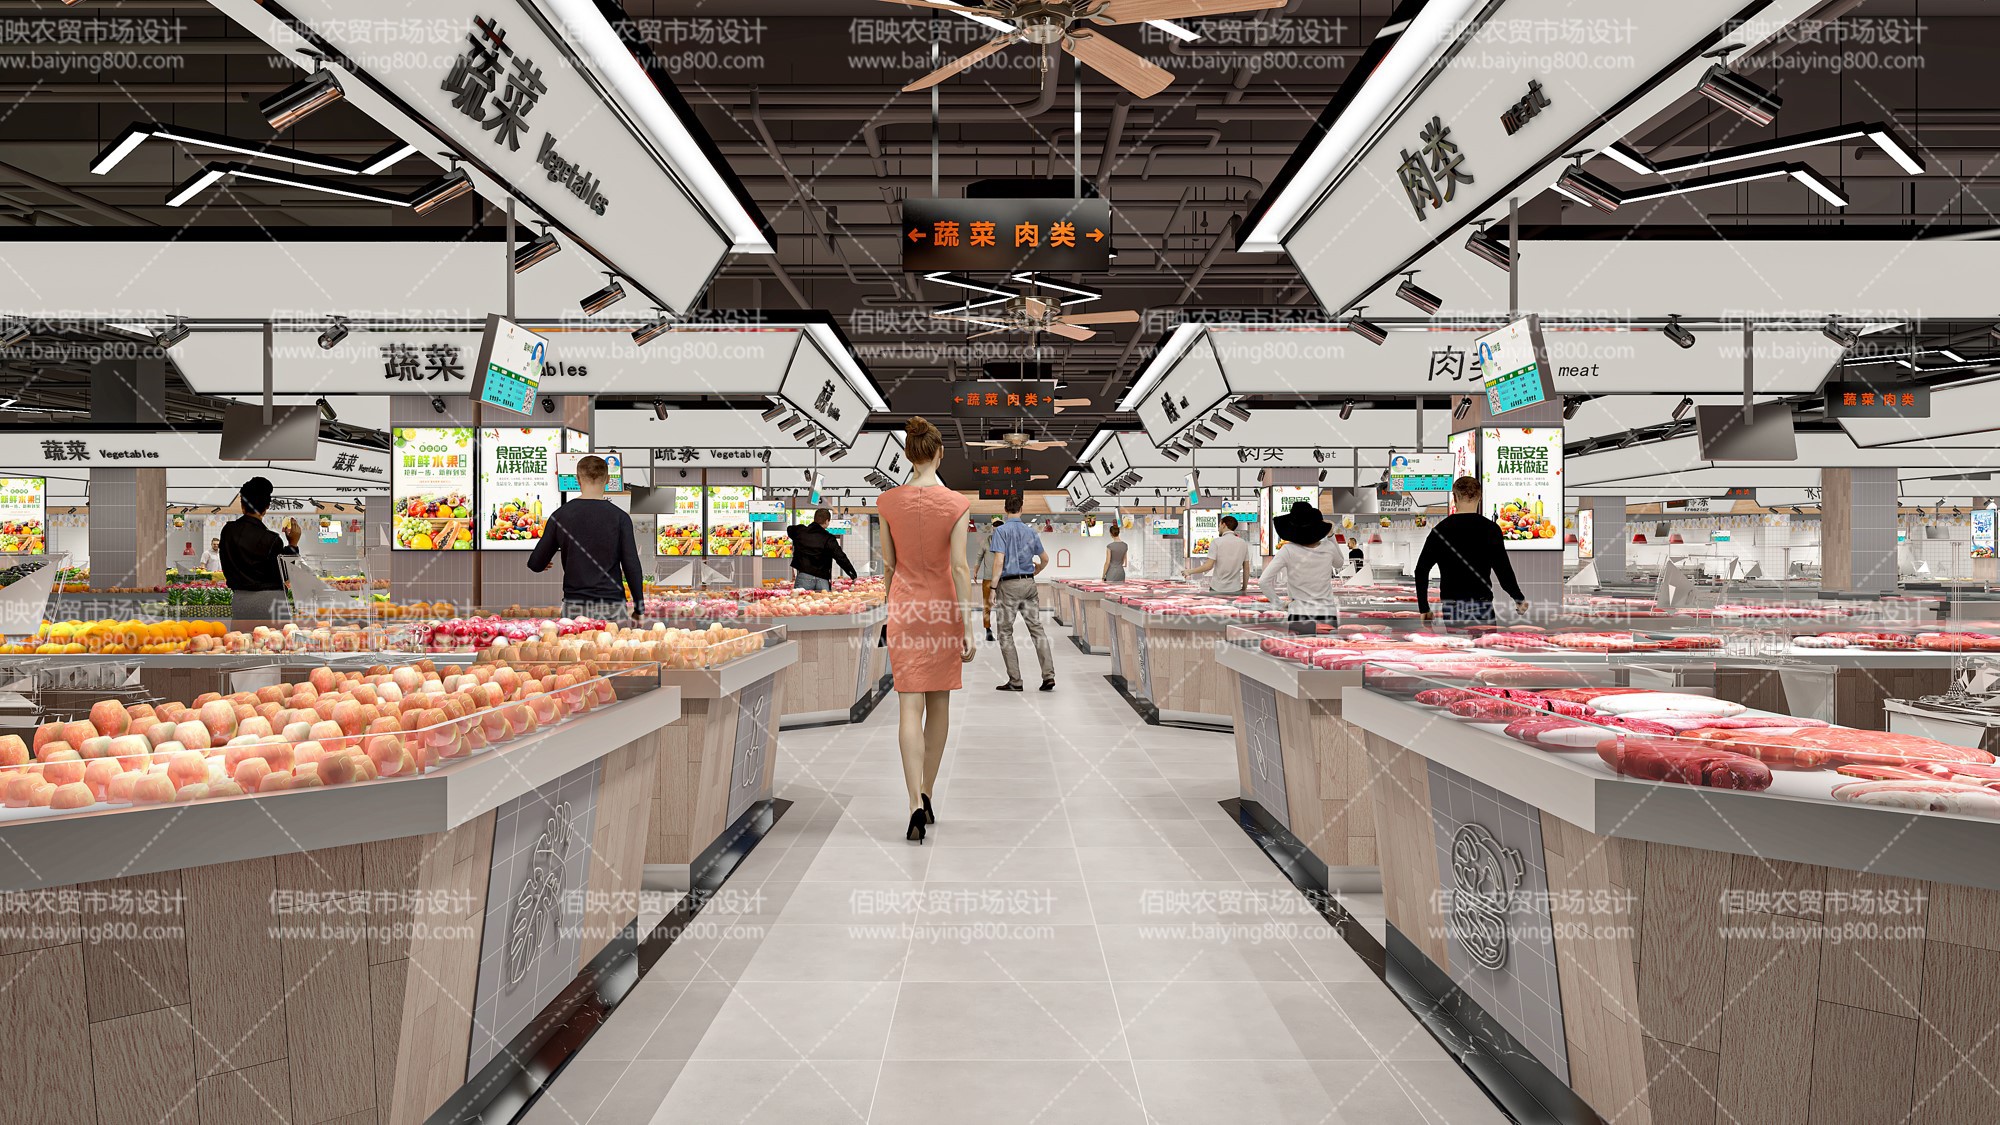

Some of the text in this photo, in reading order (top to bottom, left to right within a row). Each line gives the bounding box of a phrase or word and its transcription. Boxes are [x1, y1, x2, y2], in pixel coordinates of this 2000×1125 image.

[441, 15, 609, 216] 蔬菜 Vegetables
[1397, 79, 1551, 222] 肉类 meat
[934, 221, 1076, 247] 蔬菜 肉类
[380, 343, 465, 381] 蔬菜
[1558, 364, 1600, 377] meat
[967, 393, 1038, 406] 蔬菜 肉类
[1843, 392, 1915, 406] 蔬菜 肉类
[40, 440, 159, 460] 蔬菜 Vegetables
[496, 446, 547, 459] 食品安全
[710, 449, 765, 459] Vegetable
[1497, 446, 1548, 459] 食品安全
[333, 452, 359, 472] 蔬菜
[403, 455, 458, 467] 新鲜水果
[496, 460, 547, 473] 从我做起
[1497, 460, 1548, 473] 从我做起
